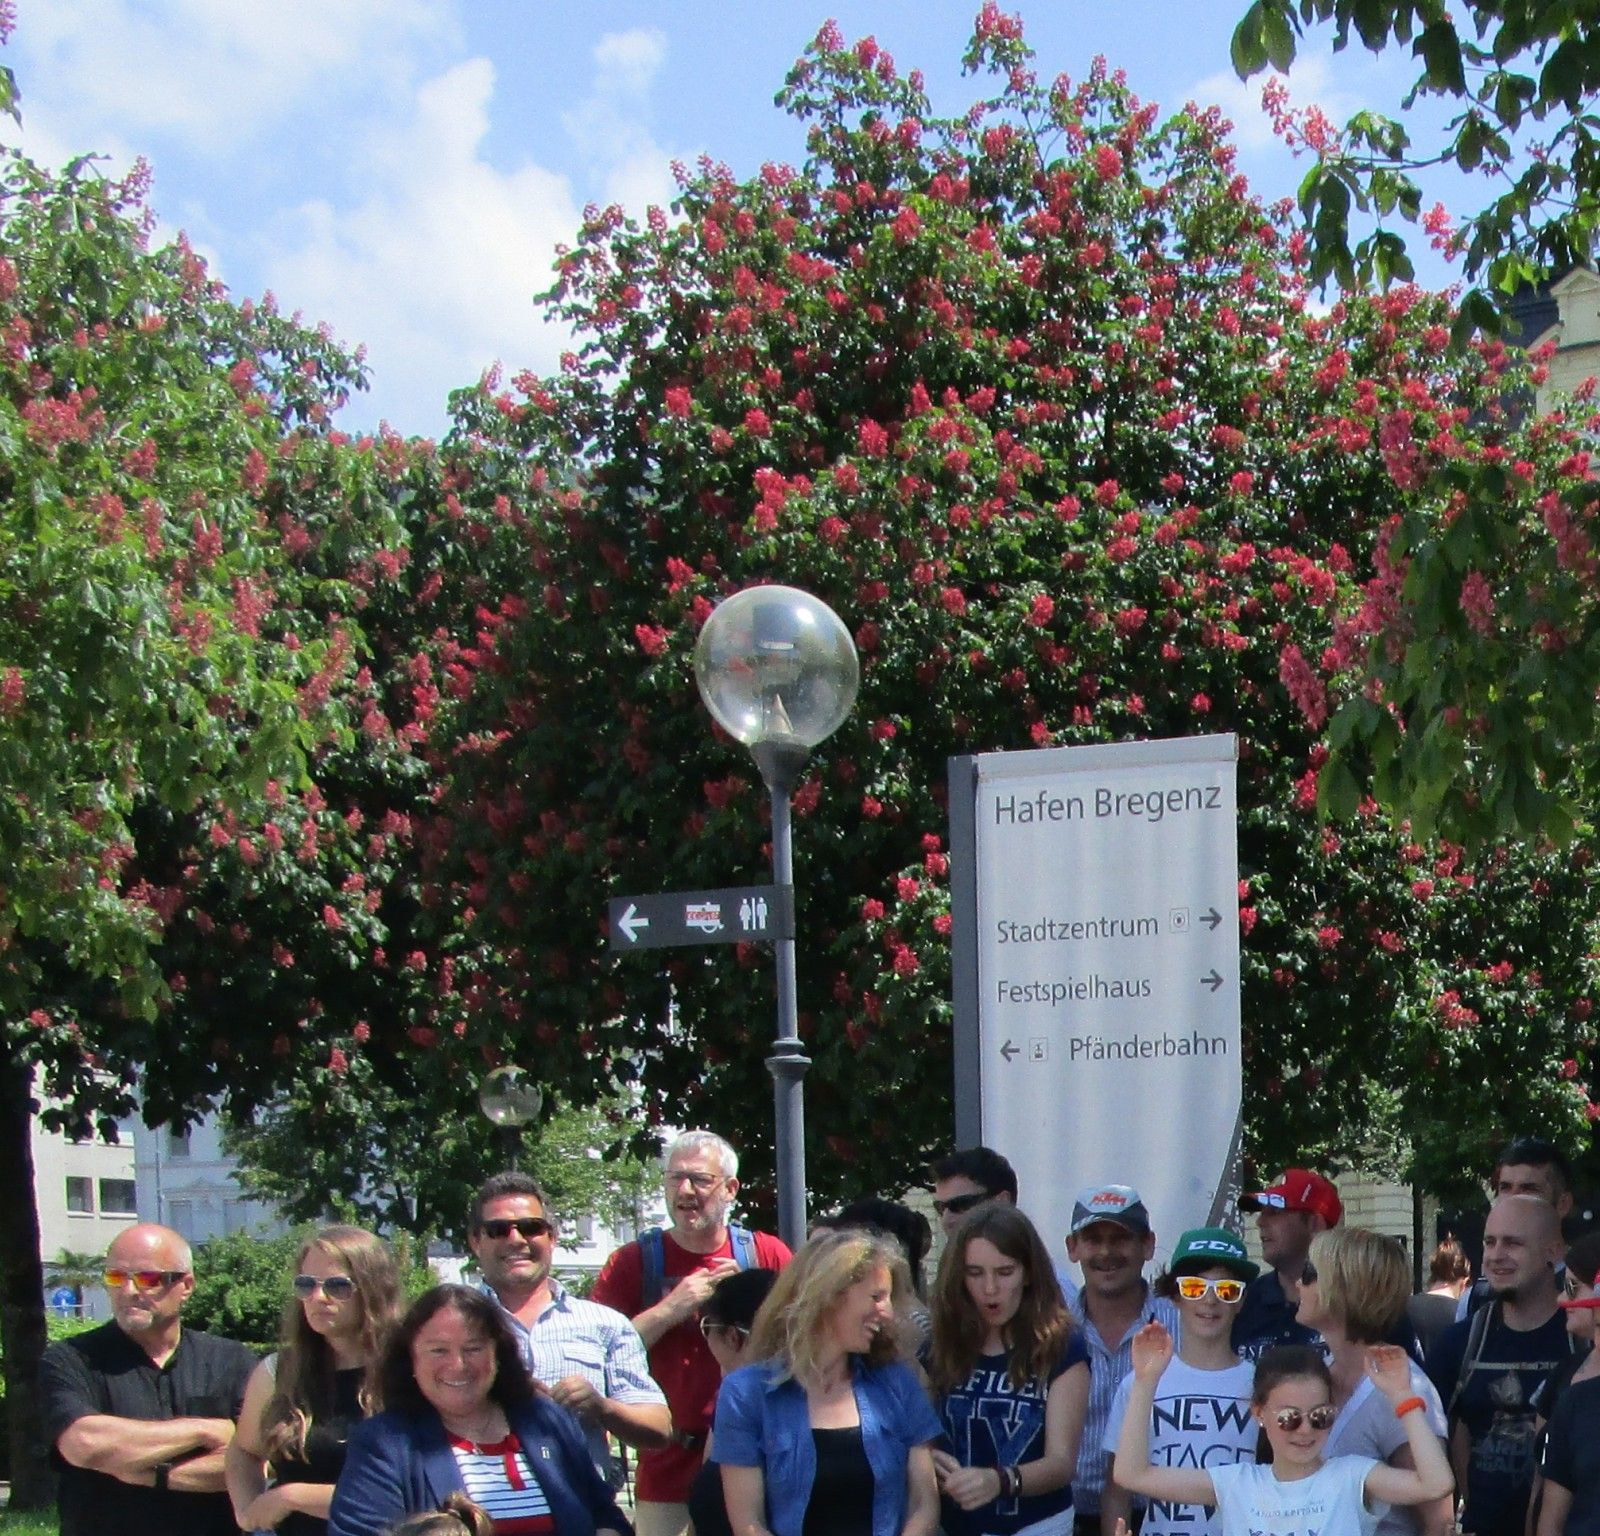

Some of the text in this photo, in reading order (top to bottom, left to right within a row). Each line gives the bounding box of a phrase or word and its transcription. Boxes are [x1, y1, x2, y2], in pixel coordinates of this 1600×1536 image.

[995, 785, 1222, 825] Hafen Bregenz
[996, 915, 1159, 944] Stadtzentrum
[997, 974, 1151, 1007] Festspielhaus
[1069, 1030, 1228, 1061] Pfänderbahn
[1152, 1397, 1252, 1437] NEW
